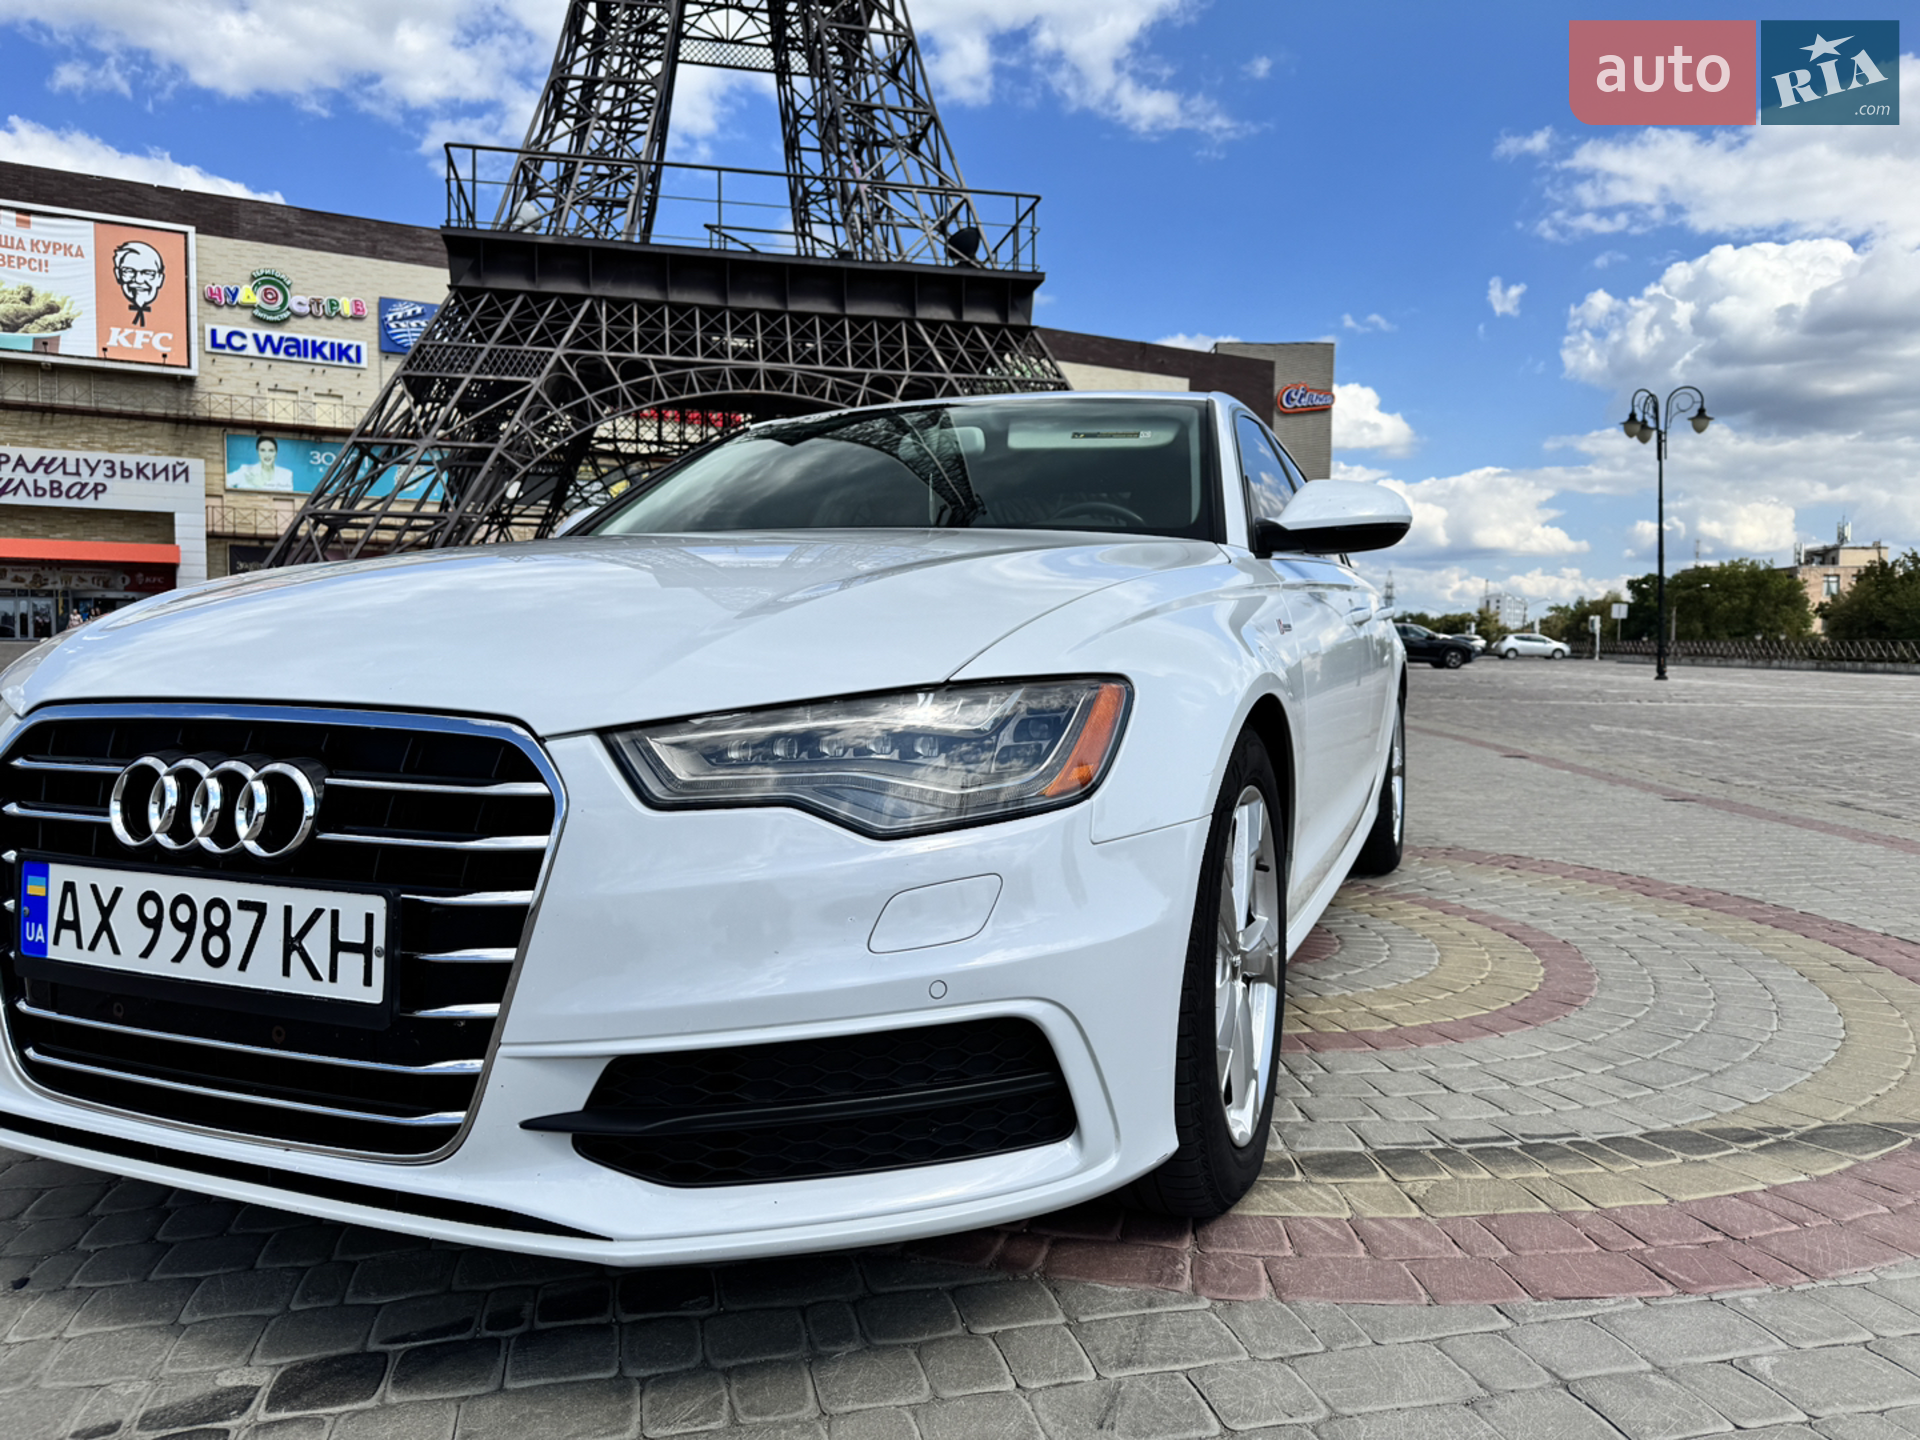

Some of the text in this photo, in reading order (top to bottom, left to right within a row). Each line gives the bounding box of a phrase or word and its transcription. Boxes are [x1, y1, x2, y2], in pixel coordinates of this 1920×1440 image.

[30, 238, 86, 259] КУРКА
[106, 327, 173, 352] KFC
[210, 328, 248, 351] LC
[145, 576, 164, 584] KFC
[25, 921, 45, 944] UA
[52, 880, 375, 987] AX 9987 KH
